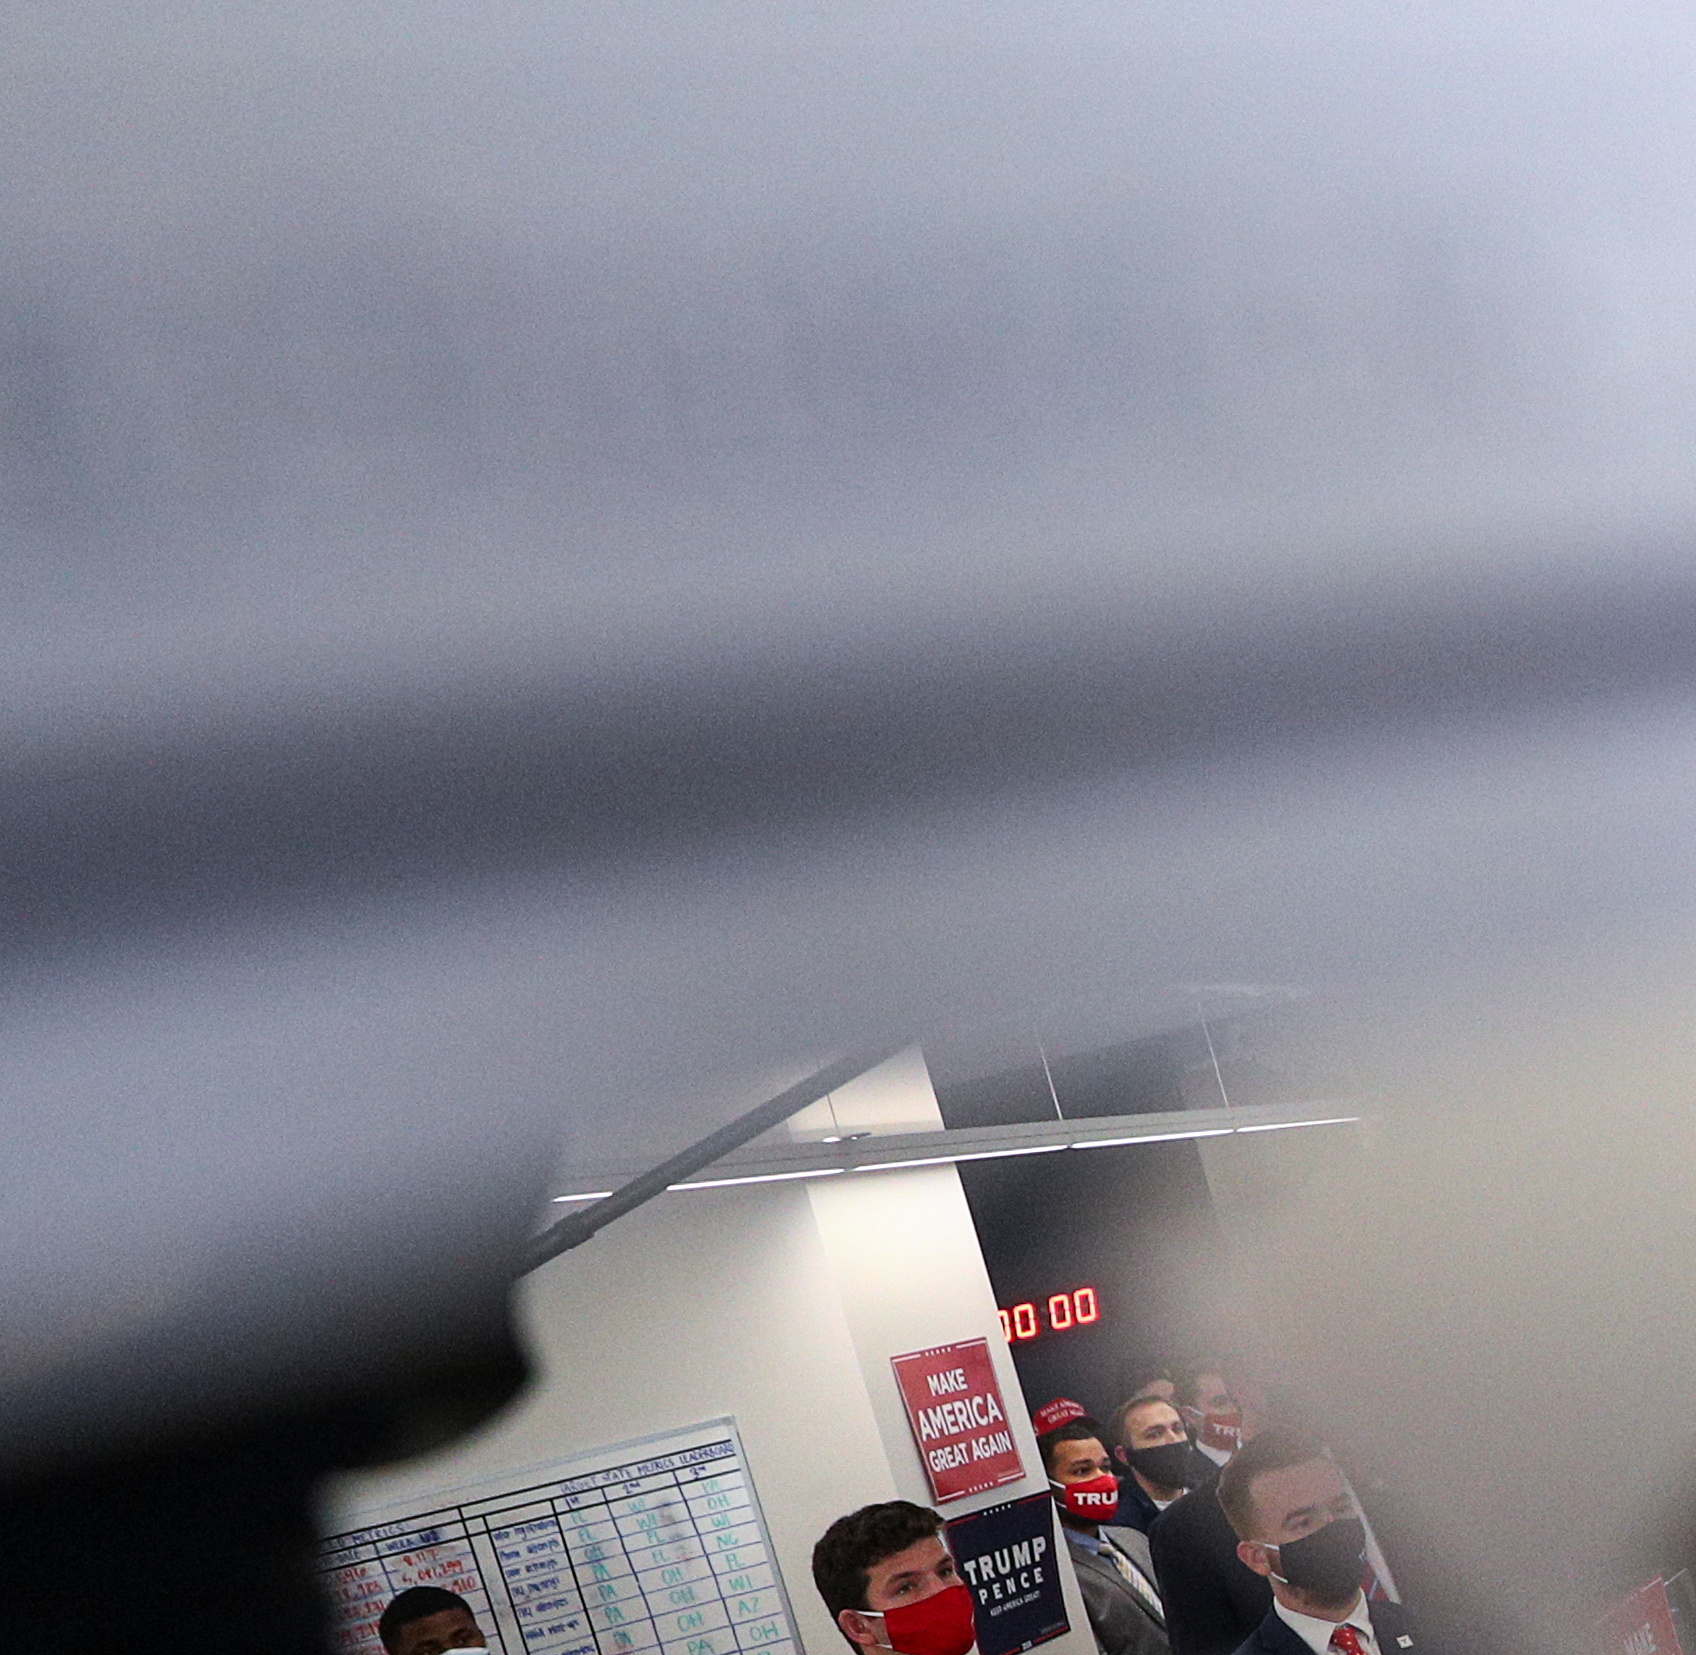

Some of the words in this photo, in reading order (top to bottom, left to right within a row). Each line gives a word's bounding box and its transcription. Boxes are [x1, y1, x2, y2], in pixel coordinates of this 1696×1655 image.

[1049, 1287, 1097, 1330] 00
[926, 1368, 968, 1397] MAKE
[917, 1393, 1003, 1441] AMERICA
[928, 1443, 969, 1472] GREAT
[971, 1430, 1013, 1460] AGAIN
[963, 1536, 1047, 1586] TRUMP
[978, 1567, 1044, 1605] PENCE
[750, 1620, 779, 1641] OH
